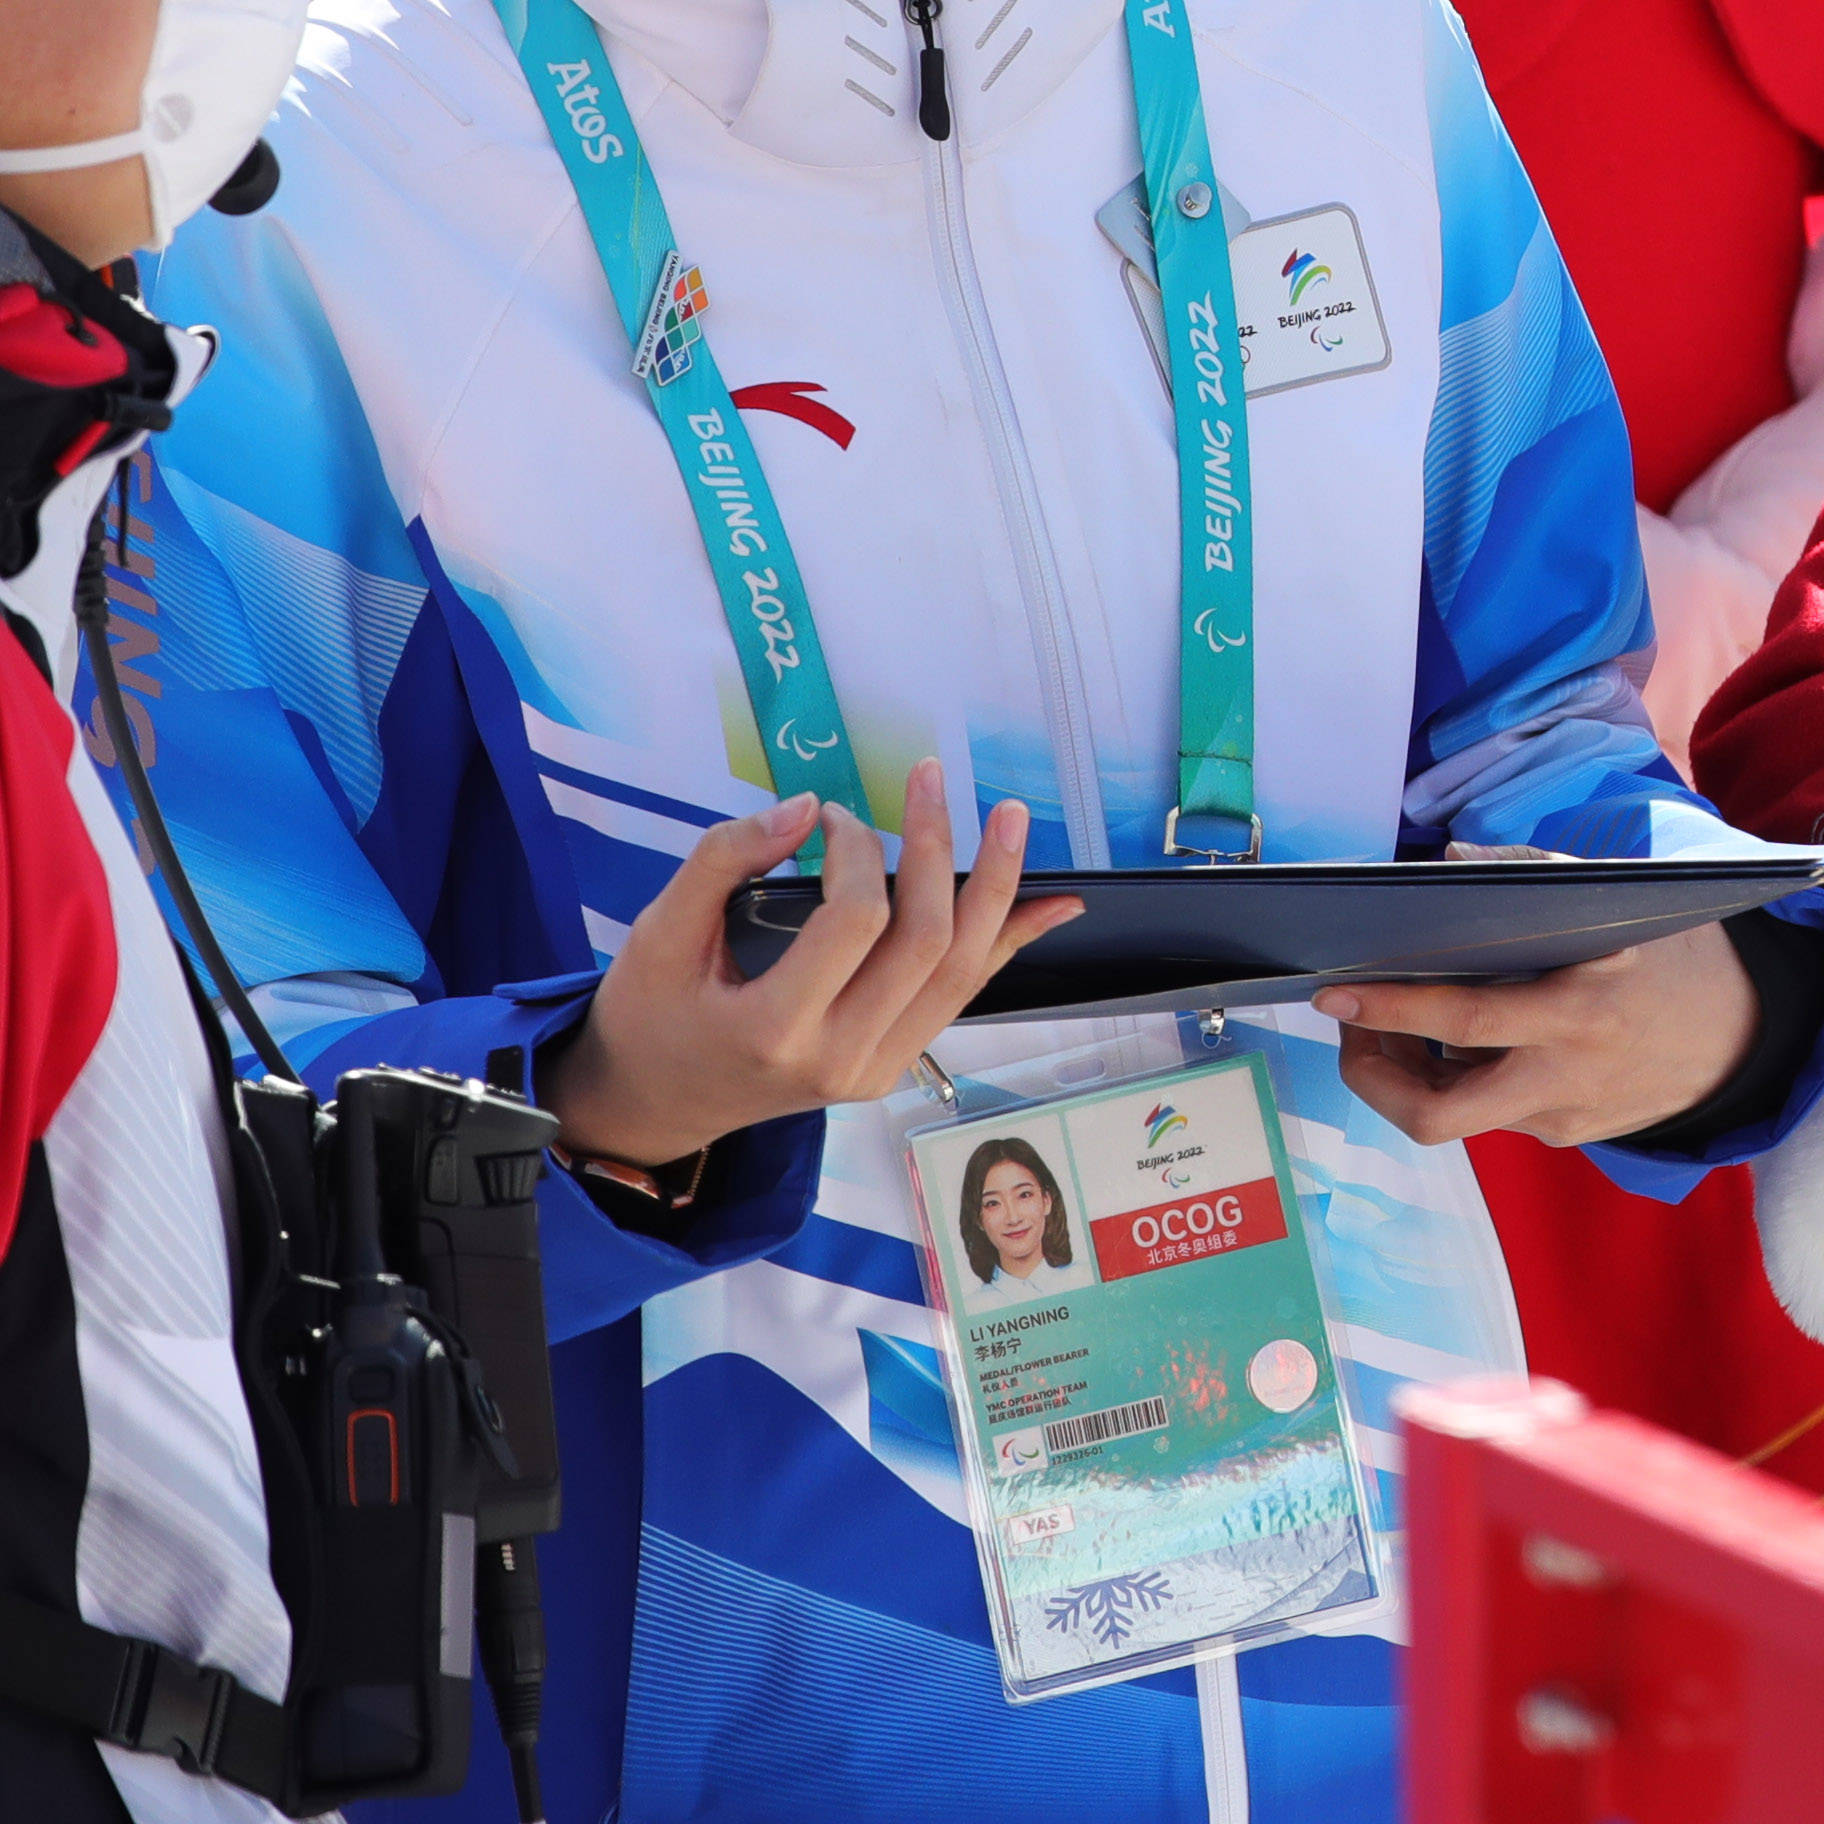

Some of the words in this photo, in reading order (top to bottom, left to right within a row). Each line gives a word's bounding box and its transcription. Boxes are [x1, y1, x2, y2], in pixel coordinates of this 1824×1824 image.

[546, 59, 624, 164] Atos
[1277, 308, 1322, 329] BEIJING
[1324, 301, 1357, 319] 2022
[1188, 291, 1228, 407] 2022
[1203, 418, 1234, 575] BEIJING
[688, 406, 770, 558] BEIJING
[742, 566, 801, 685] 2022
[1136, 1152, 1174, 1171] BEIJING
[1177, 1145, 1206, 1161] 2022
[1131, 1195, 1244, 1249] OCOG
[1147, 1229, 1238, 1266] 北京冬奥组委
[970, 1327, 985, 1342] LI
[986, 1305, 1071, 1339] YANGNING
[974, 1336, 1023, 1363] 李杨宁
[979, 1354, 1052, 1382] MEDAL/FLOWER
[1053, 1347, 1090, 1365] BEARER
[986, 1401, 1007, 1413] YMC
[1006, 1387, 1061, 1408] OPERATION
[1061, 1380, 1088, 1395] TEAM
[1023, 1512, 1061, 1535] YAS
